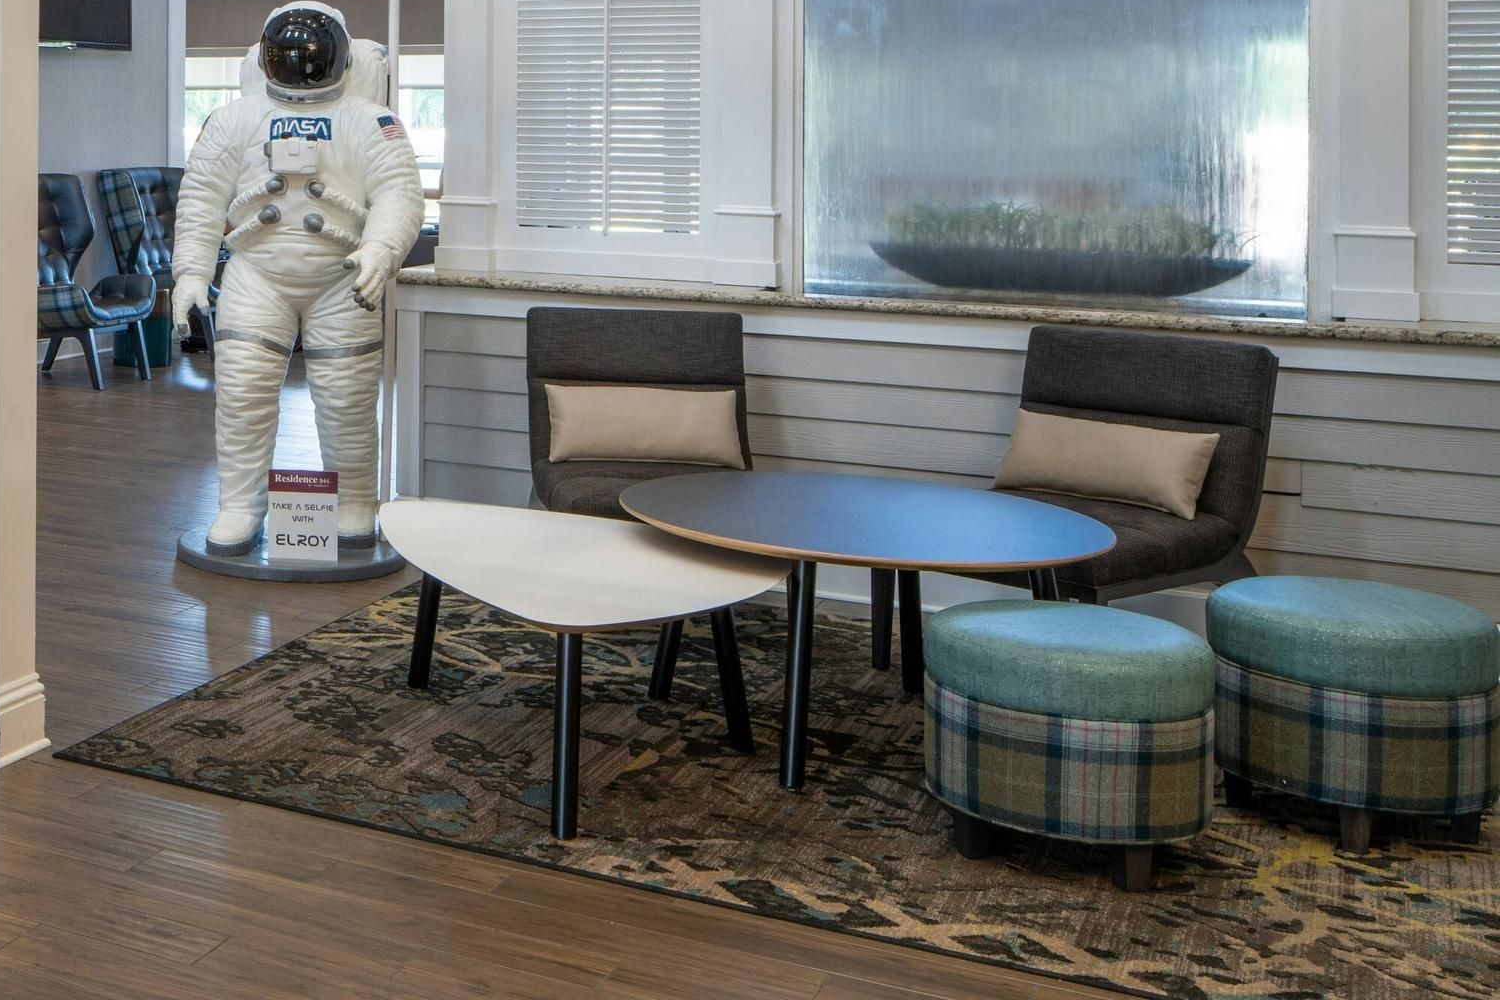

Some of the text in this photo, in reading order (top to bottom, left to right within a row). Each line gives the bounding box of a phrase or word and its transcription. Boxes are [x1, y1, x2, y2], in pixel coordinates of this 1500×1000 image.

[274, 119, 328, 136] NASA
[275, 474, 318, 483] Residence
[272, 502, 293, 510] TAKE
[276, 534, 329, 548] ELROY
